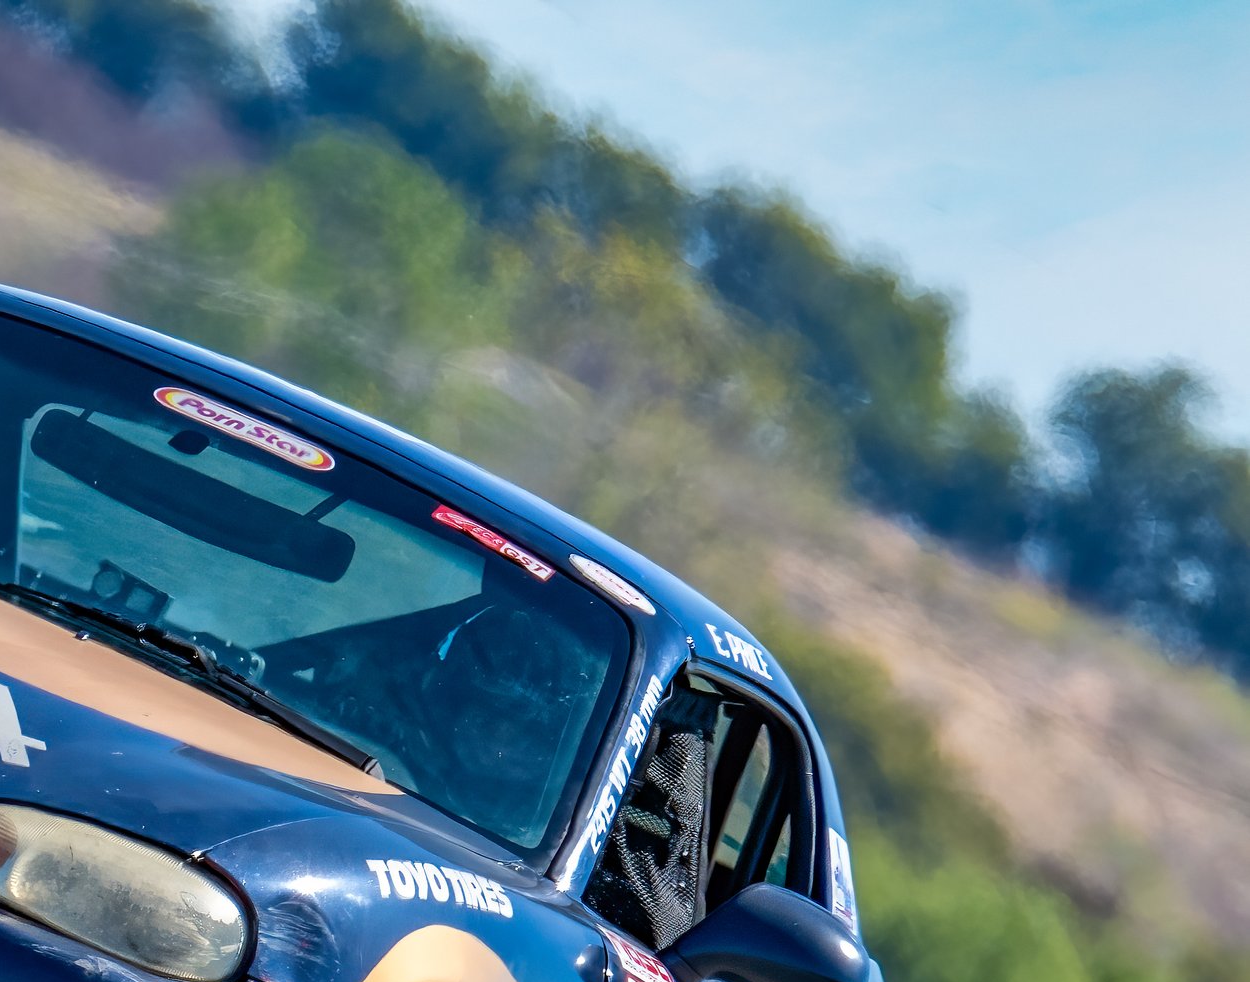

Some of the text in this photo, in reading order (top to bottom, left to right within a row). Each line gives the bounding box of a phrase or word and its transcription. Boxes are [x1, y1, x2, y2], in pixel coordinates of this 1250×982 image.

[177, 398, 312, 459] Porn Star
[625, 711, 648, 759] 38
[365, 859, 514, 919] TOYO TIRES
